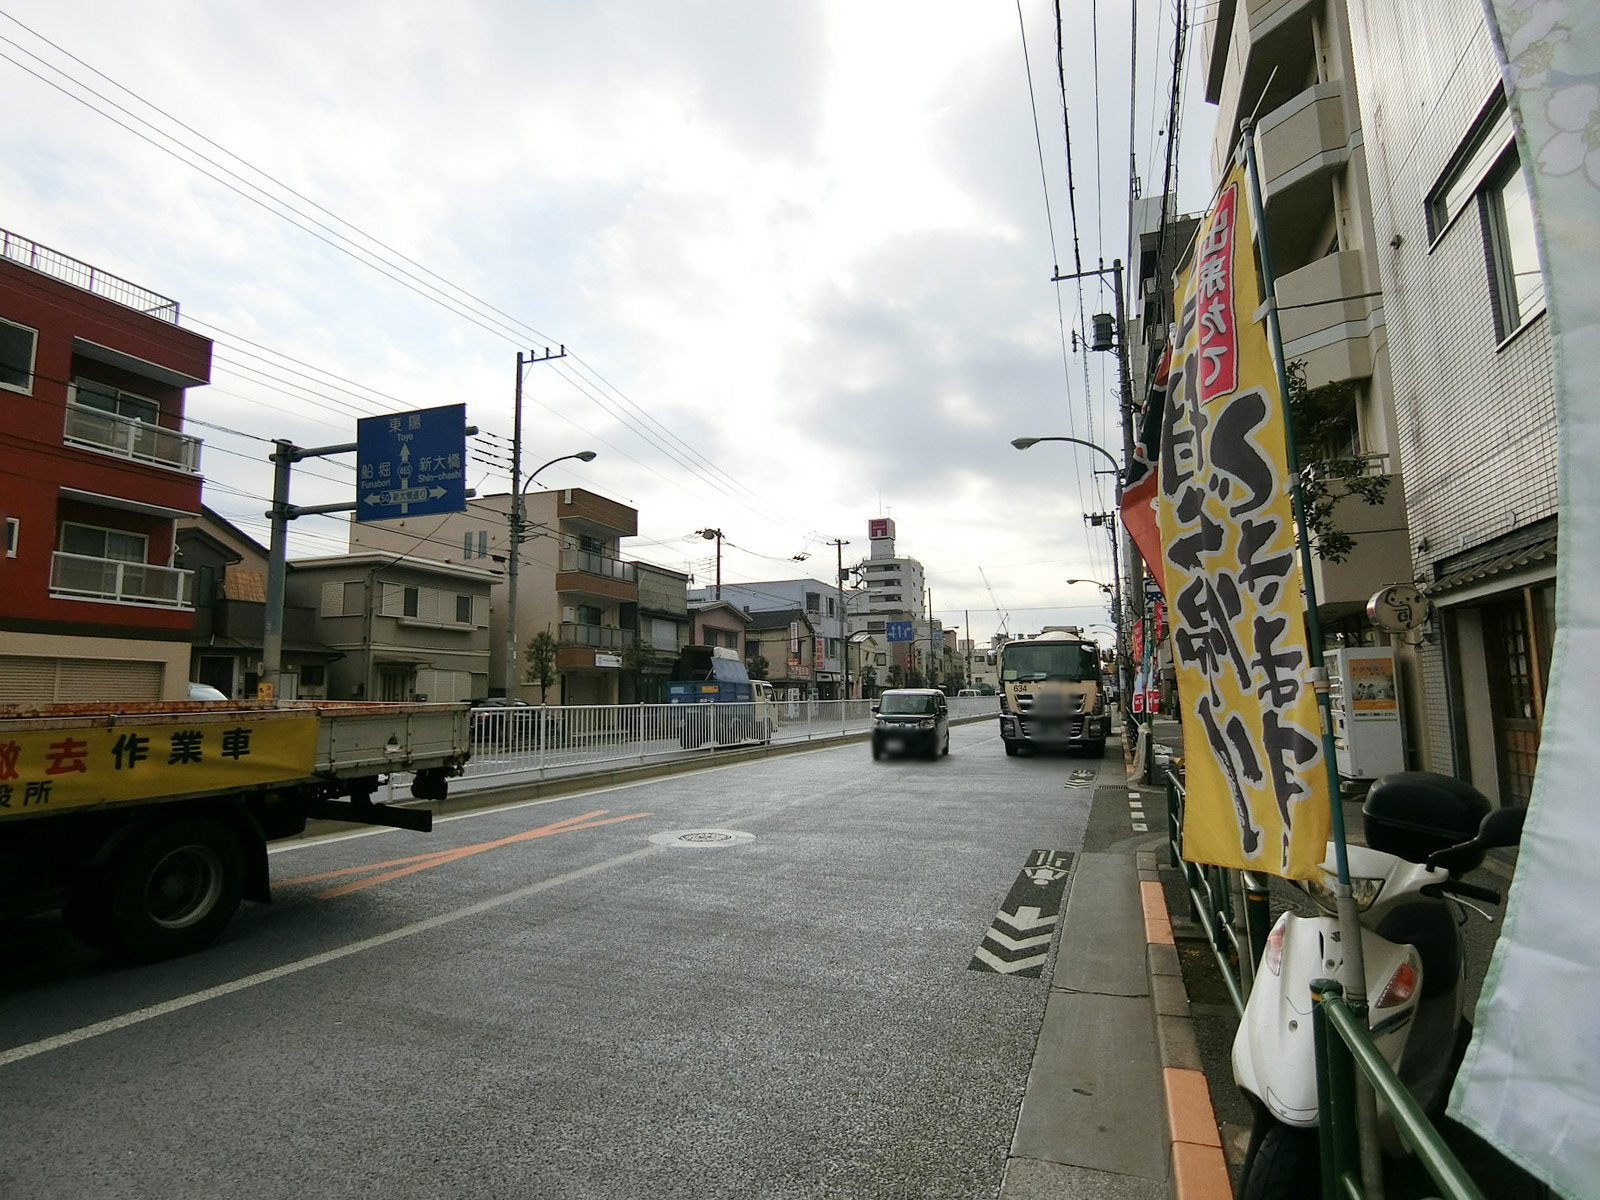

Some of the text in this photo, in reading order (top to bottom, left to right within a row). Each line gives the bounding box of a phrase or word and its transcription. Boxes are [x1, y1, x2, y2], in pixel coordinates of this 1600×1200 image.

[388, 414, 421, 433] 東陽
[397, 433, 413, 442] Toyo
[419, 452, 461, 472] 新大橋
[361, 462, 391, 479] 船堀
[418, 471, 462, 483] Shin-ohashi
[361, 478, 391, 489] Funabori
[393, 488, 427, 500] 新大橋通り
[1013, 684, 1027, 692] 634
